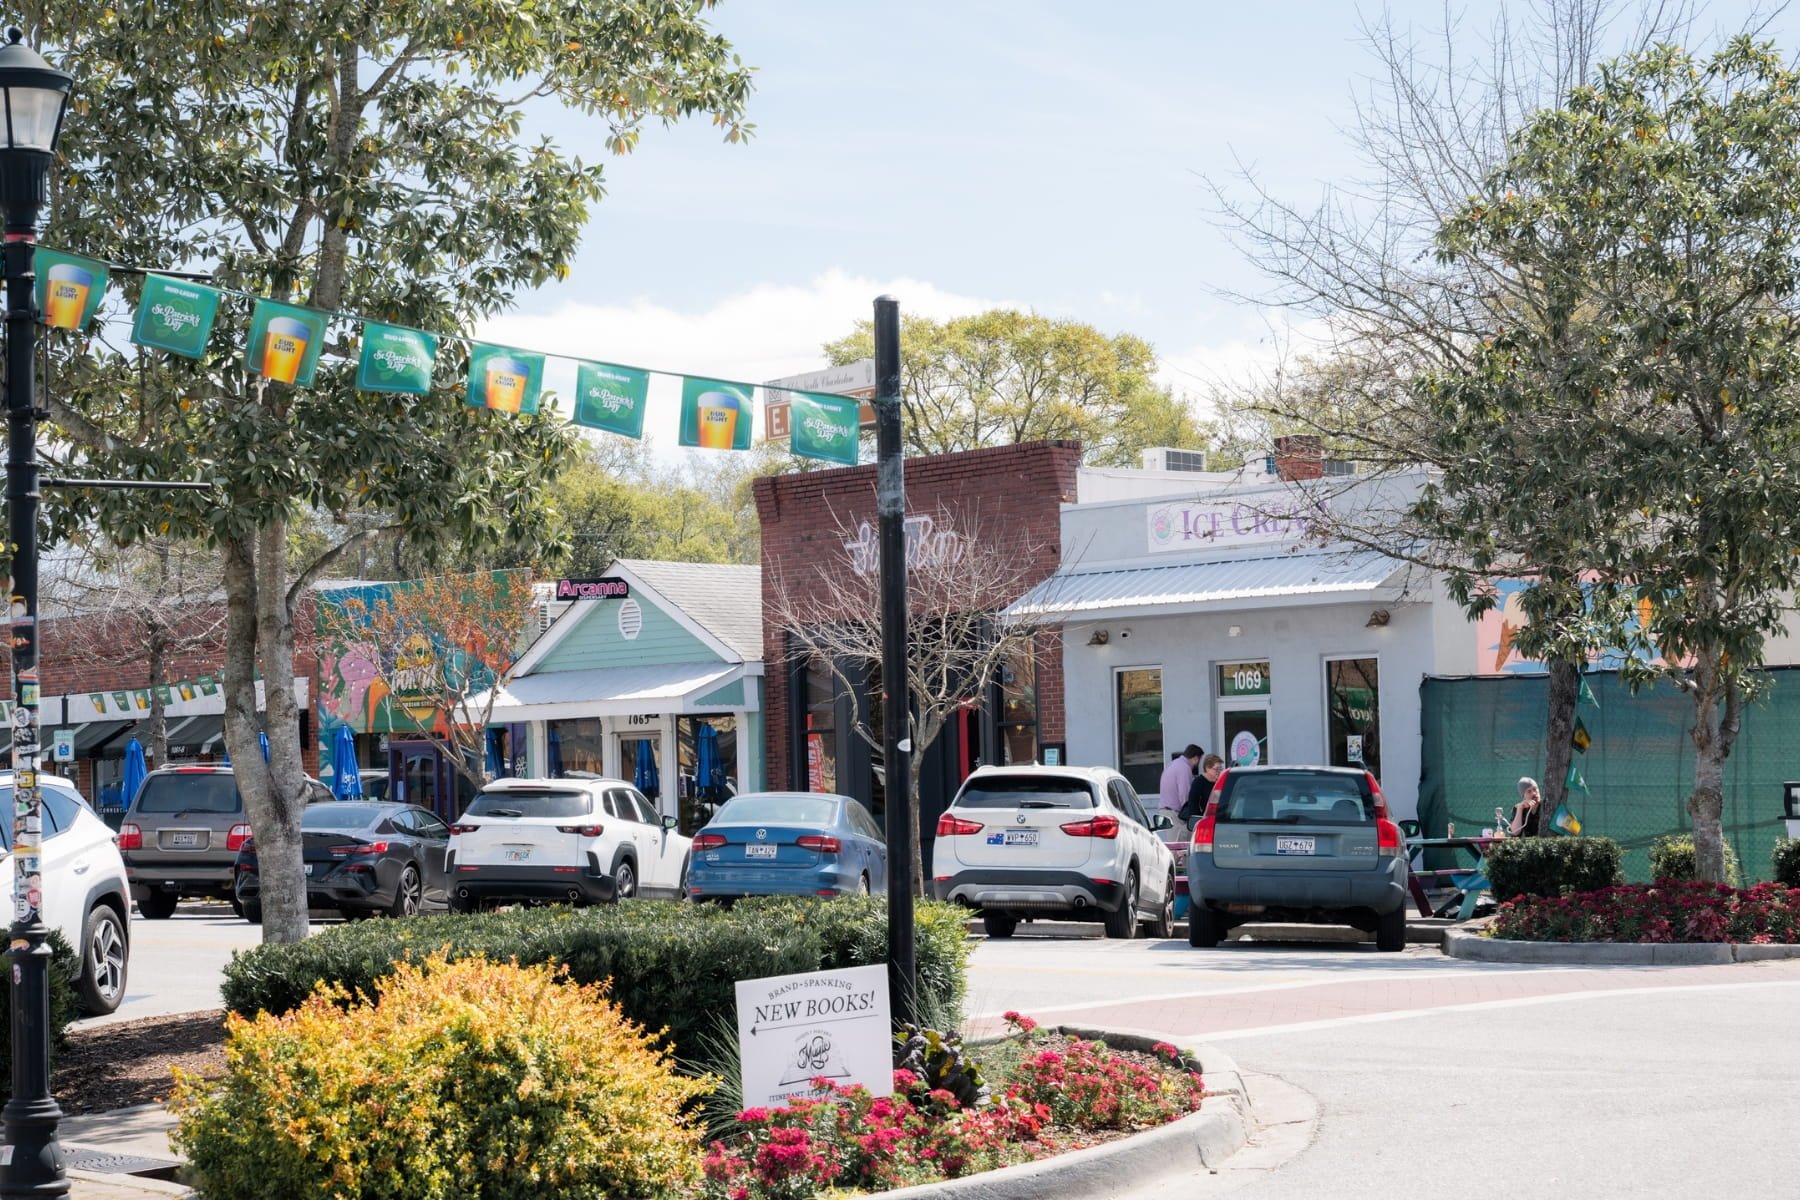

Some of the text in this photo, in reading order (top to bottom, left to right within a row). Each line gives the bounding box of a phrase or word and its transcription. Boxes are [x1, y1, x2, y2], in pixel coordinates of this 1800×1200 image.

[55, 291, 79, 300] LIGHT
[60, 285, 77, 293] BUD
[179, 289, 200, 300] LIGHT
[164, 315, 184, 332] Day
[274, 344, 297, 354] LIGHT
[278, 338, 295, 347] BUD
[1181, 510, 1225, 541] ICE
[558, 580, 627, 597] Arcanna
[1232, 670, 1262, 690] 1069
[768, 978, 852, 999] BRAND-SPANKING
[754, 990, 875, 1024] NEW BOOKS!
